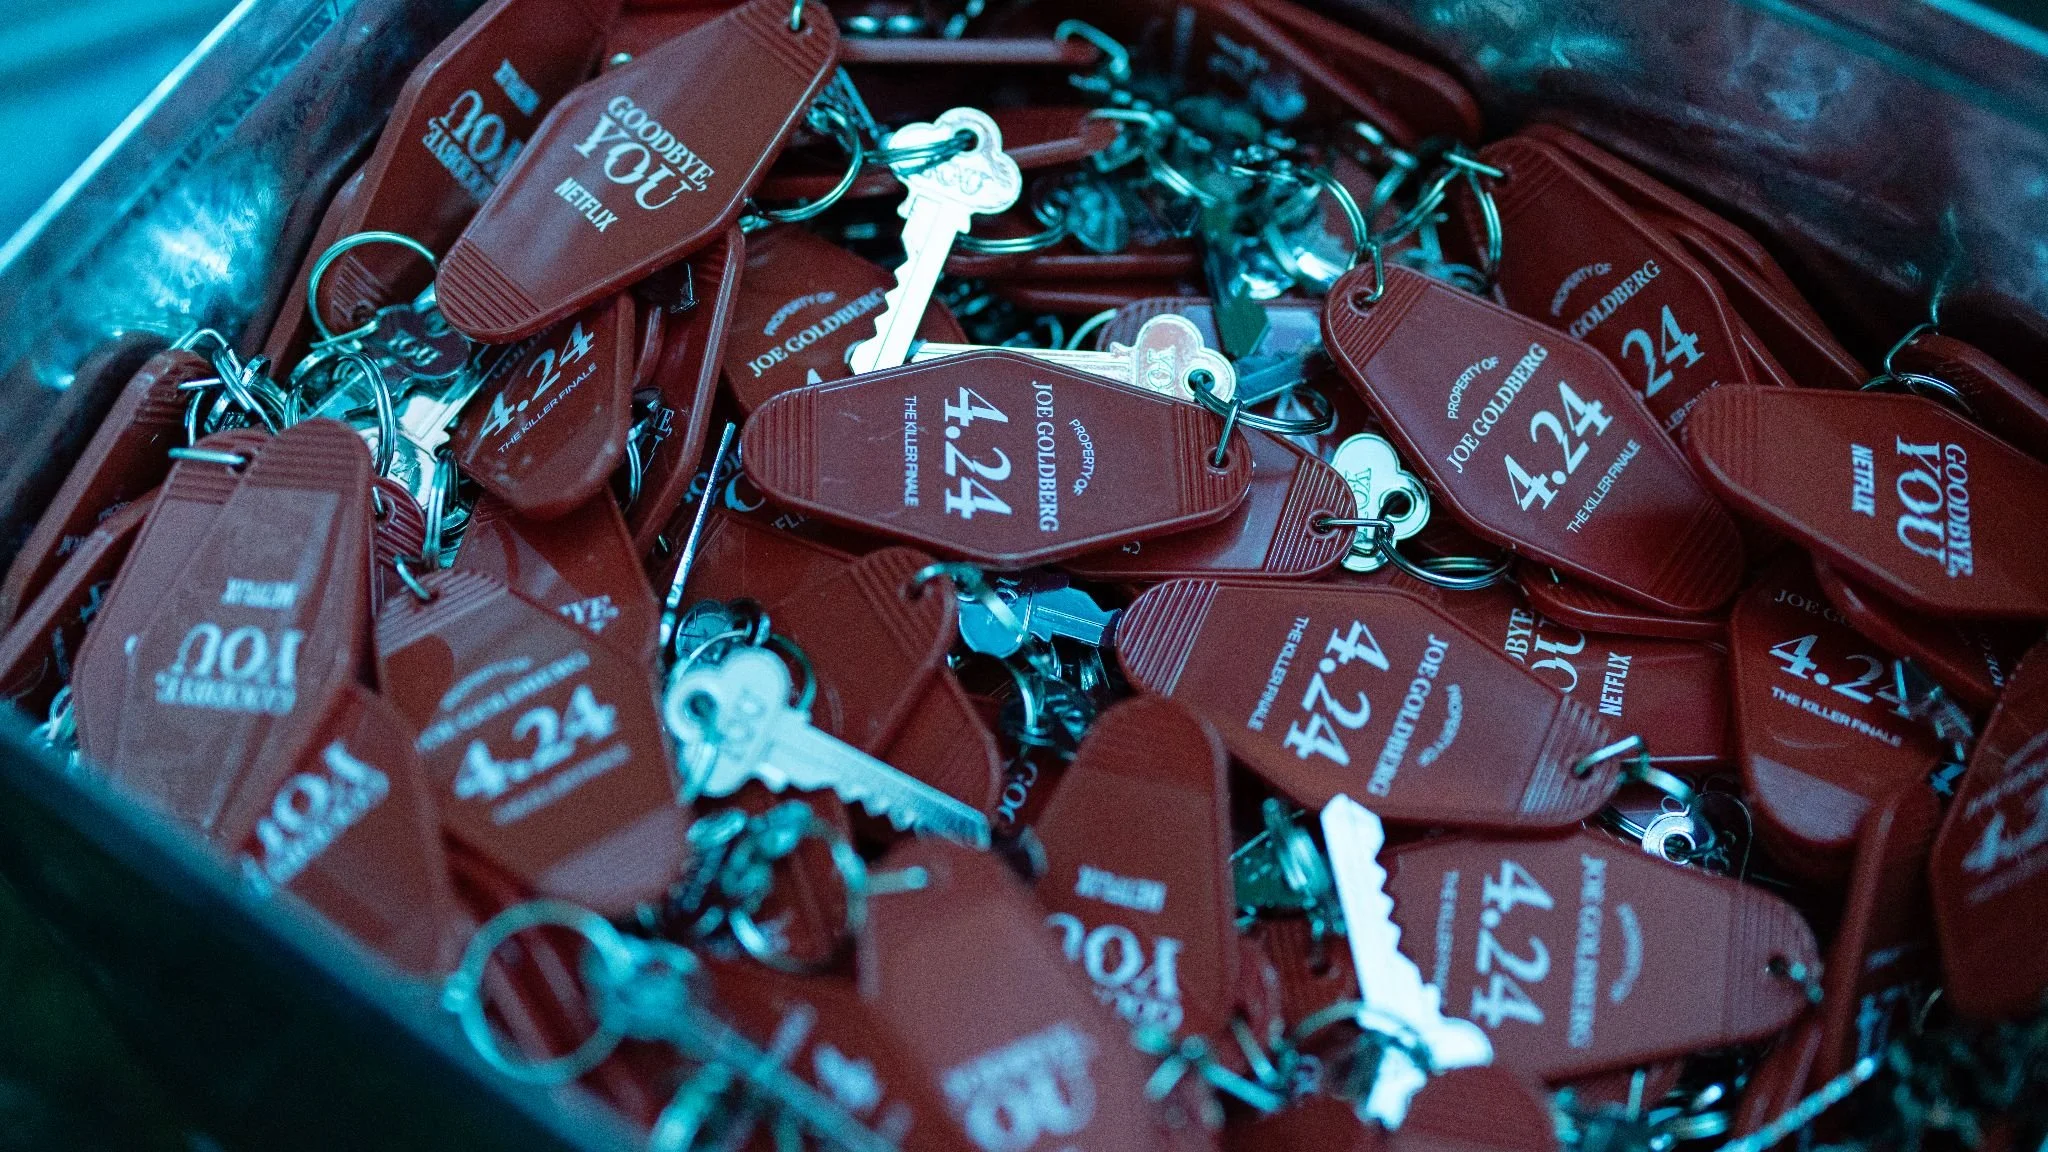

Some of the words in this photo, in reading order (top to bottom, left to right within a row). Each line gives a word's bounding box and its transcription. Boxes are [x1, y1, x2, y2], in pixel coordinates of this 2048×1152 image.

[573, 113, 692, 210] YOU
[607, 95, 715, 192] GOODBYE,
[554, 177, 618, 232] NETFLIX
[1569, 259, 1661, 342] GOLDBERG
[479, 321, 594, 440] 4.24
[748, 347, 789, 377] JOE
[1032, 380, 1054, 418] JOE
[1448, 362, 1483, 420] PROPERTY
[1481, 355, 1500, 372] OF
[498, 431, 521, 453] THE
[521, 398, 559, 434] KILLER
[558, 362, 598, 400] FINALE
[904, 395, 917, 420] THE
[904, 421, 918, 462] KILLER
[1446, 432, 1480, 474] JOE
[1473, 343, 1548, 436] GOLDBERG
[1504, 380, 1614, 512] 4.24
[904, 462, 919, 507] FINALE
[944, 386, 1012, 520] 4.24
[1036, 421, 1059, 532] GOLDBERG
[1069, 419, 1094, 480] PROPERTY
[1073, 478, 1088, 496] OF
[1566, 510, 1588, 533] THE
[1583, 472, 1615, 516] KILLER
[1609, 439, 1642, 485] FINALE
[1851, 443, 1875, 517] NETFLIX
[1896, 436, 1947, 564] YOU
[1288, 617, 1310, 643] THE
[1417, 632, 1449, 679] JOE
[1283, 619, 1390, 767] 4.24
[1599, 651, 1633, 716] NETFLIX
[1771, 686, 1801, 707] THE
[1800, 697, 1851, 727] KILLER
[453, 683, 618, 801] 4.24
[1366, 677, 1432, 797] GOLDBERG
[1470, 858, 1555, 1029] 4.24
